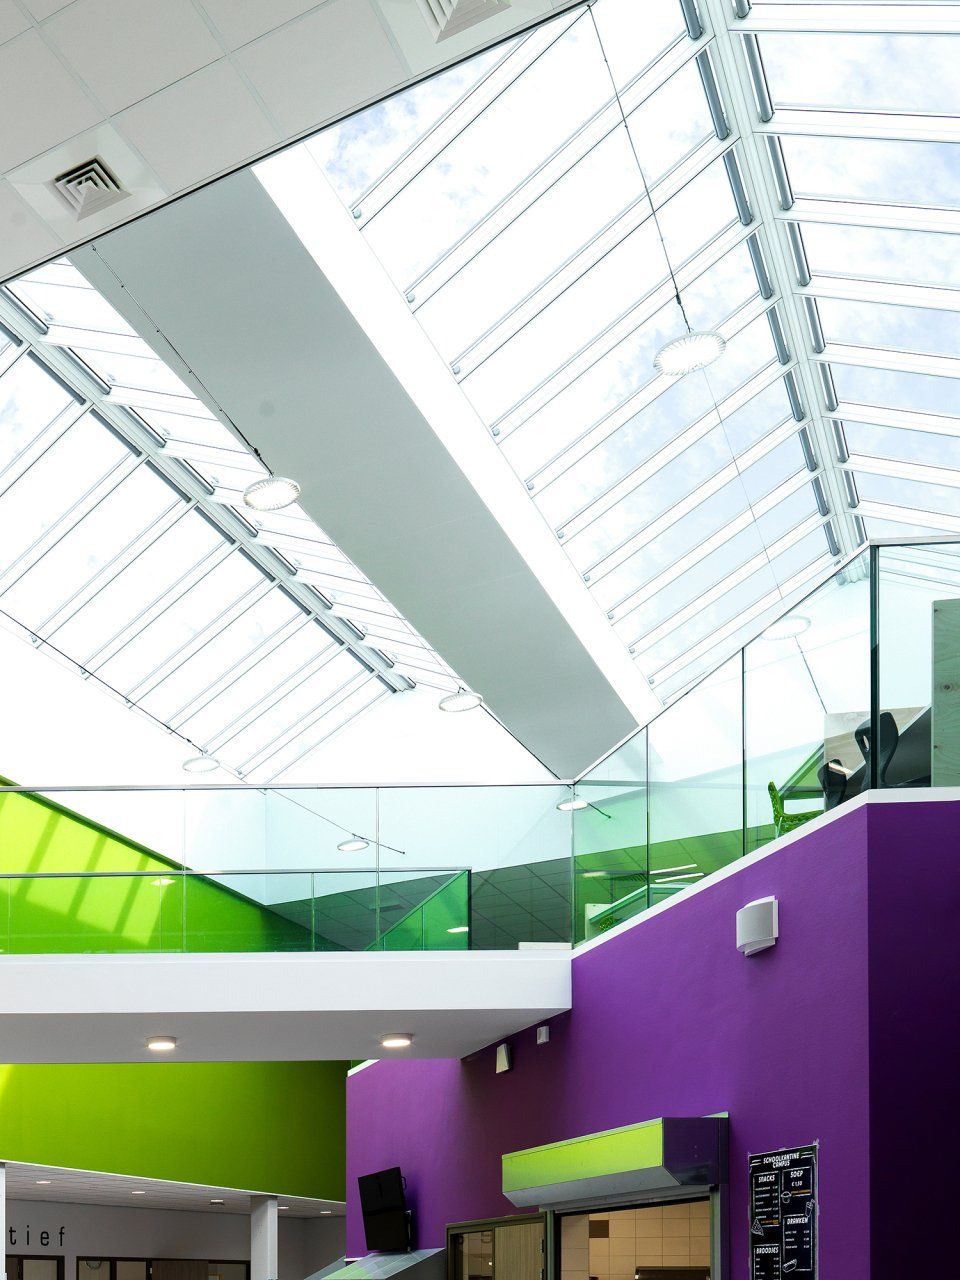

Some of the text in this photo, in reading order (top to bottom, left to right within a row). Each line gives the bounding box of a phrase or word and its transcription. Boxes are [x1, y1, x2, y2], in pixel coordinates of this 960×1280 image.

[763, 1152, 800, 1165] SCHOOLKANTINE
[772, 1160, 791, 1169] CAMPUS
[758, 1175, 776, 1183] SNACKS
[790, 1170, 804, 1179] SOEP
[756, 1246, 779, 1254] BROODJES
